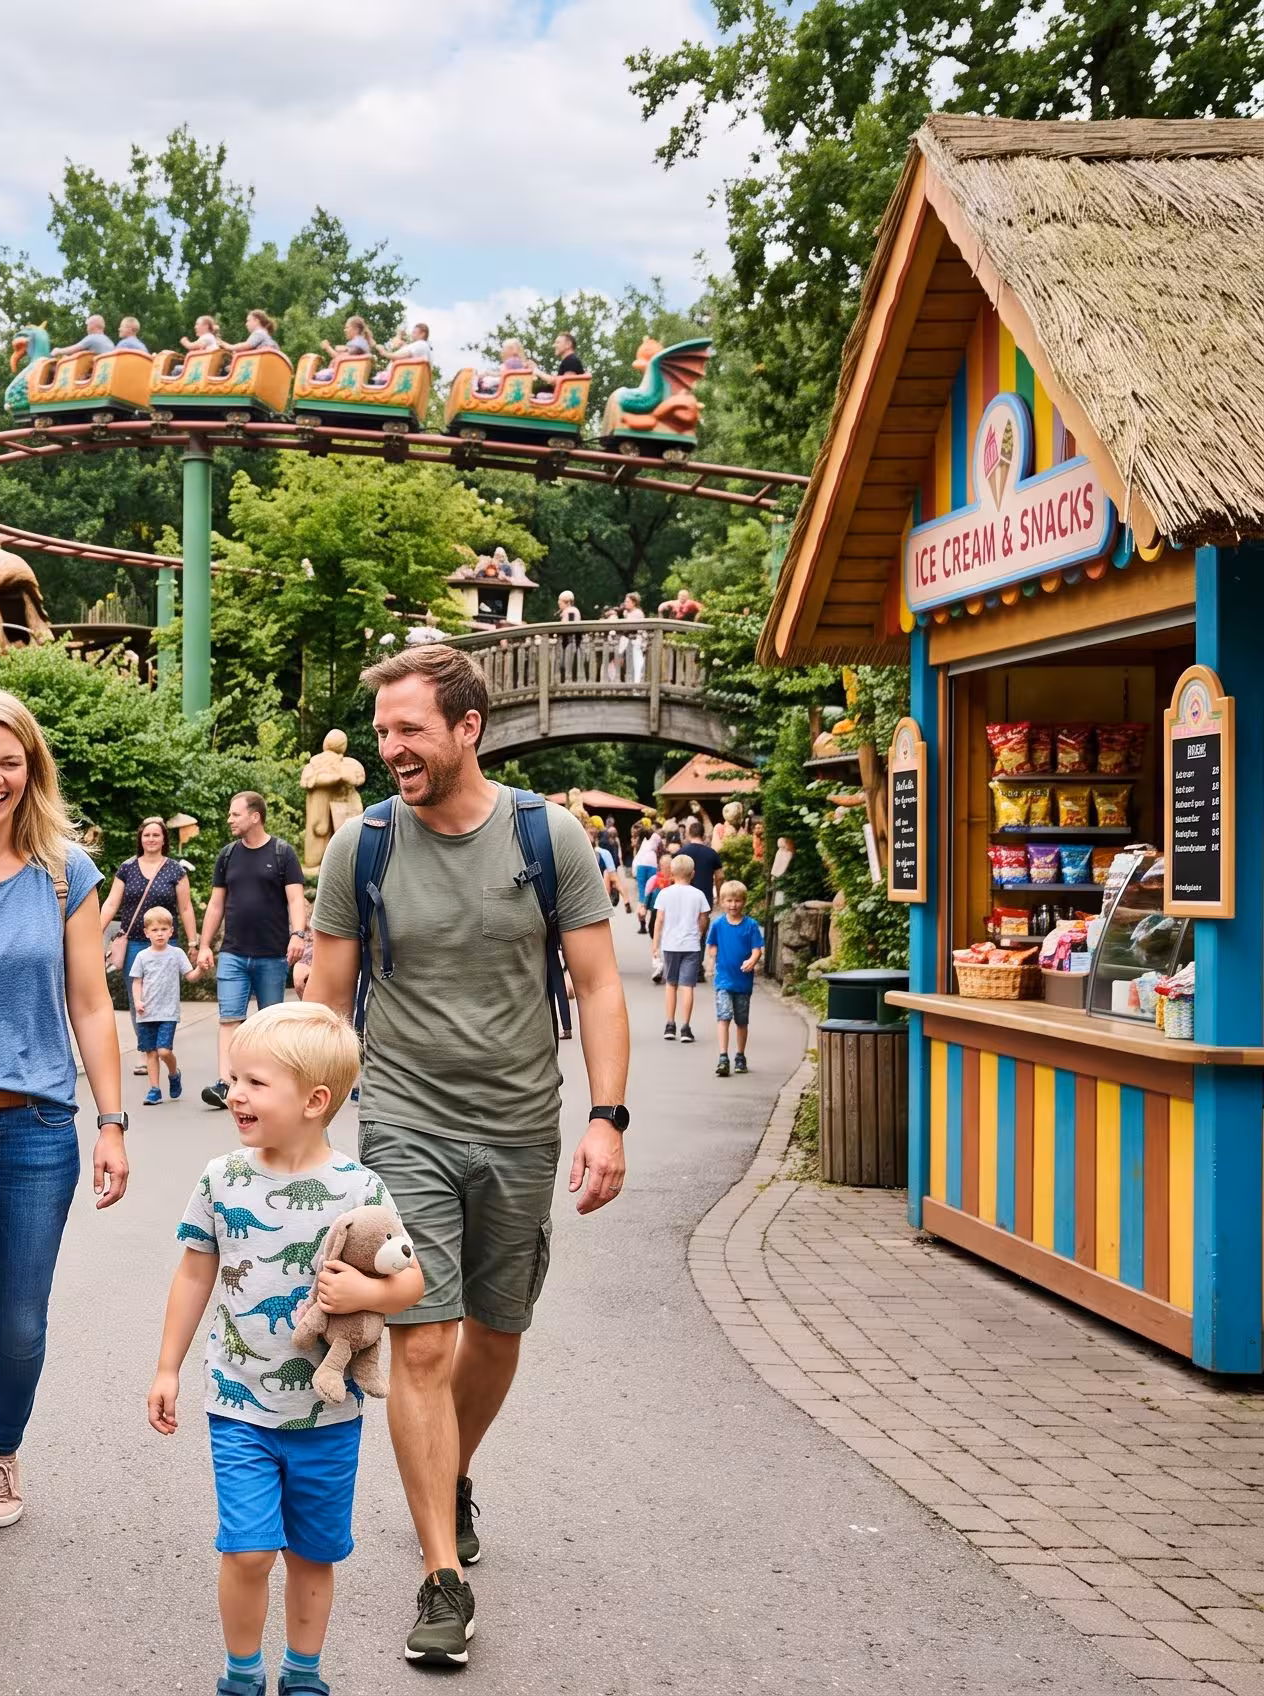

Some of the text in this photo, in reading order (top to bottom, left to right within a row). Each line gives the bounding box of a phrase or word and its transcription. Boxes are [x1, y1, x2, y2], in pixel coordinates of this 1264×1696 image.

[915, 482, 1094, 588] ICE CREAM & SNACKS
